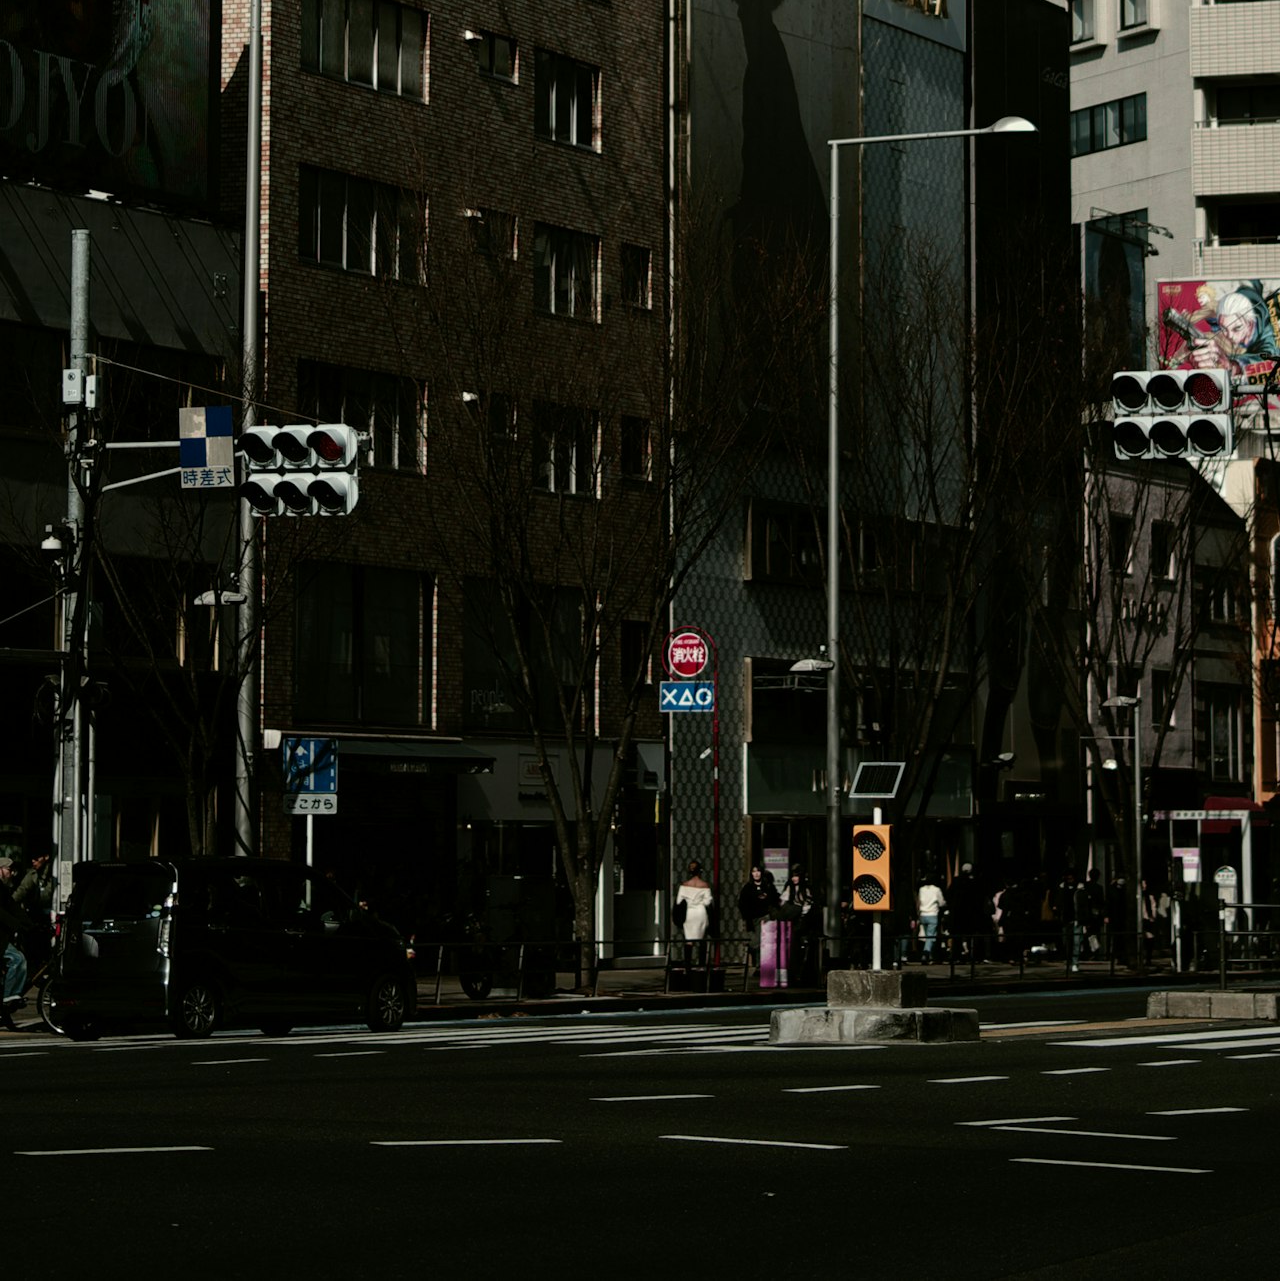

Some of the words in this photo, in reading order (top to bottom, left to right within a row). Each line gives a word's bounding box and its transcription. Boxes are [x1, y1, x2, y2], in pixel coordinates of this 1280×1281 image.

[183, 469, 233, 486] 時差式
[672, 646, 705, 664] 消火栓
[286, 798, 334, 810] ここから
